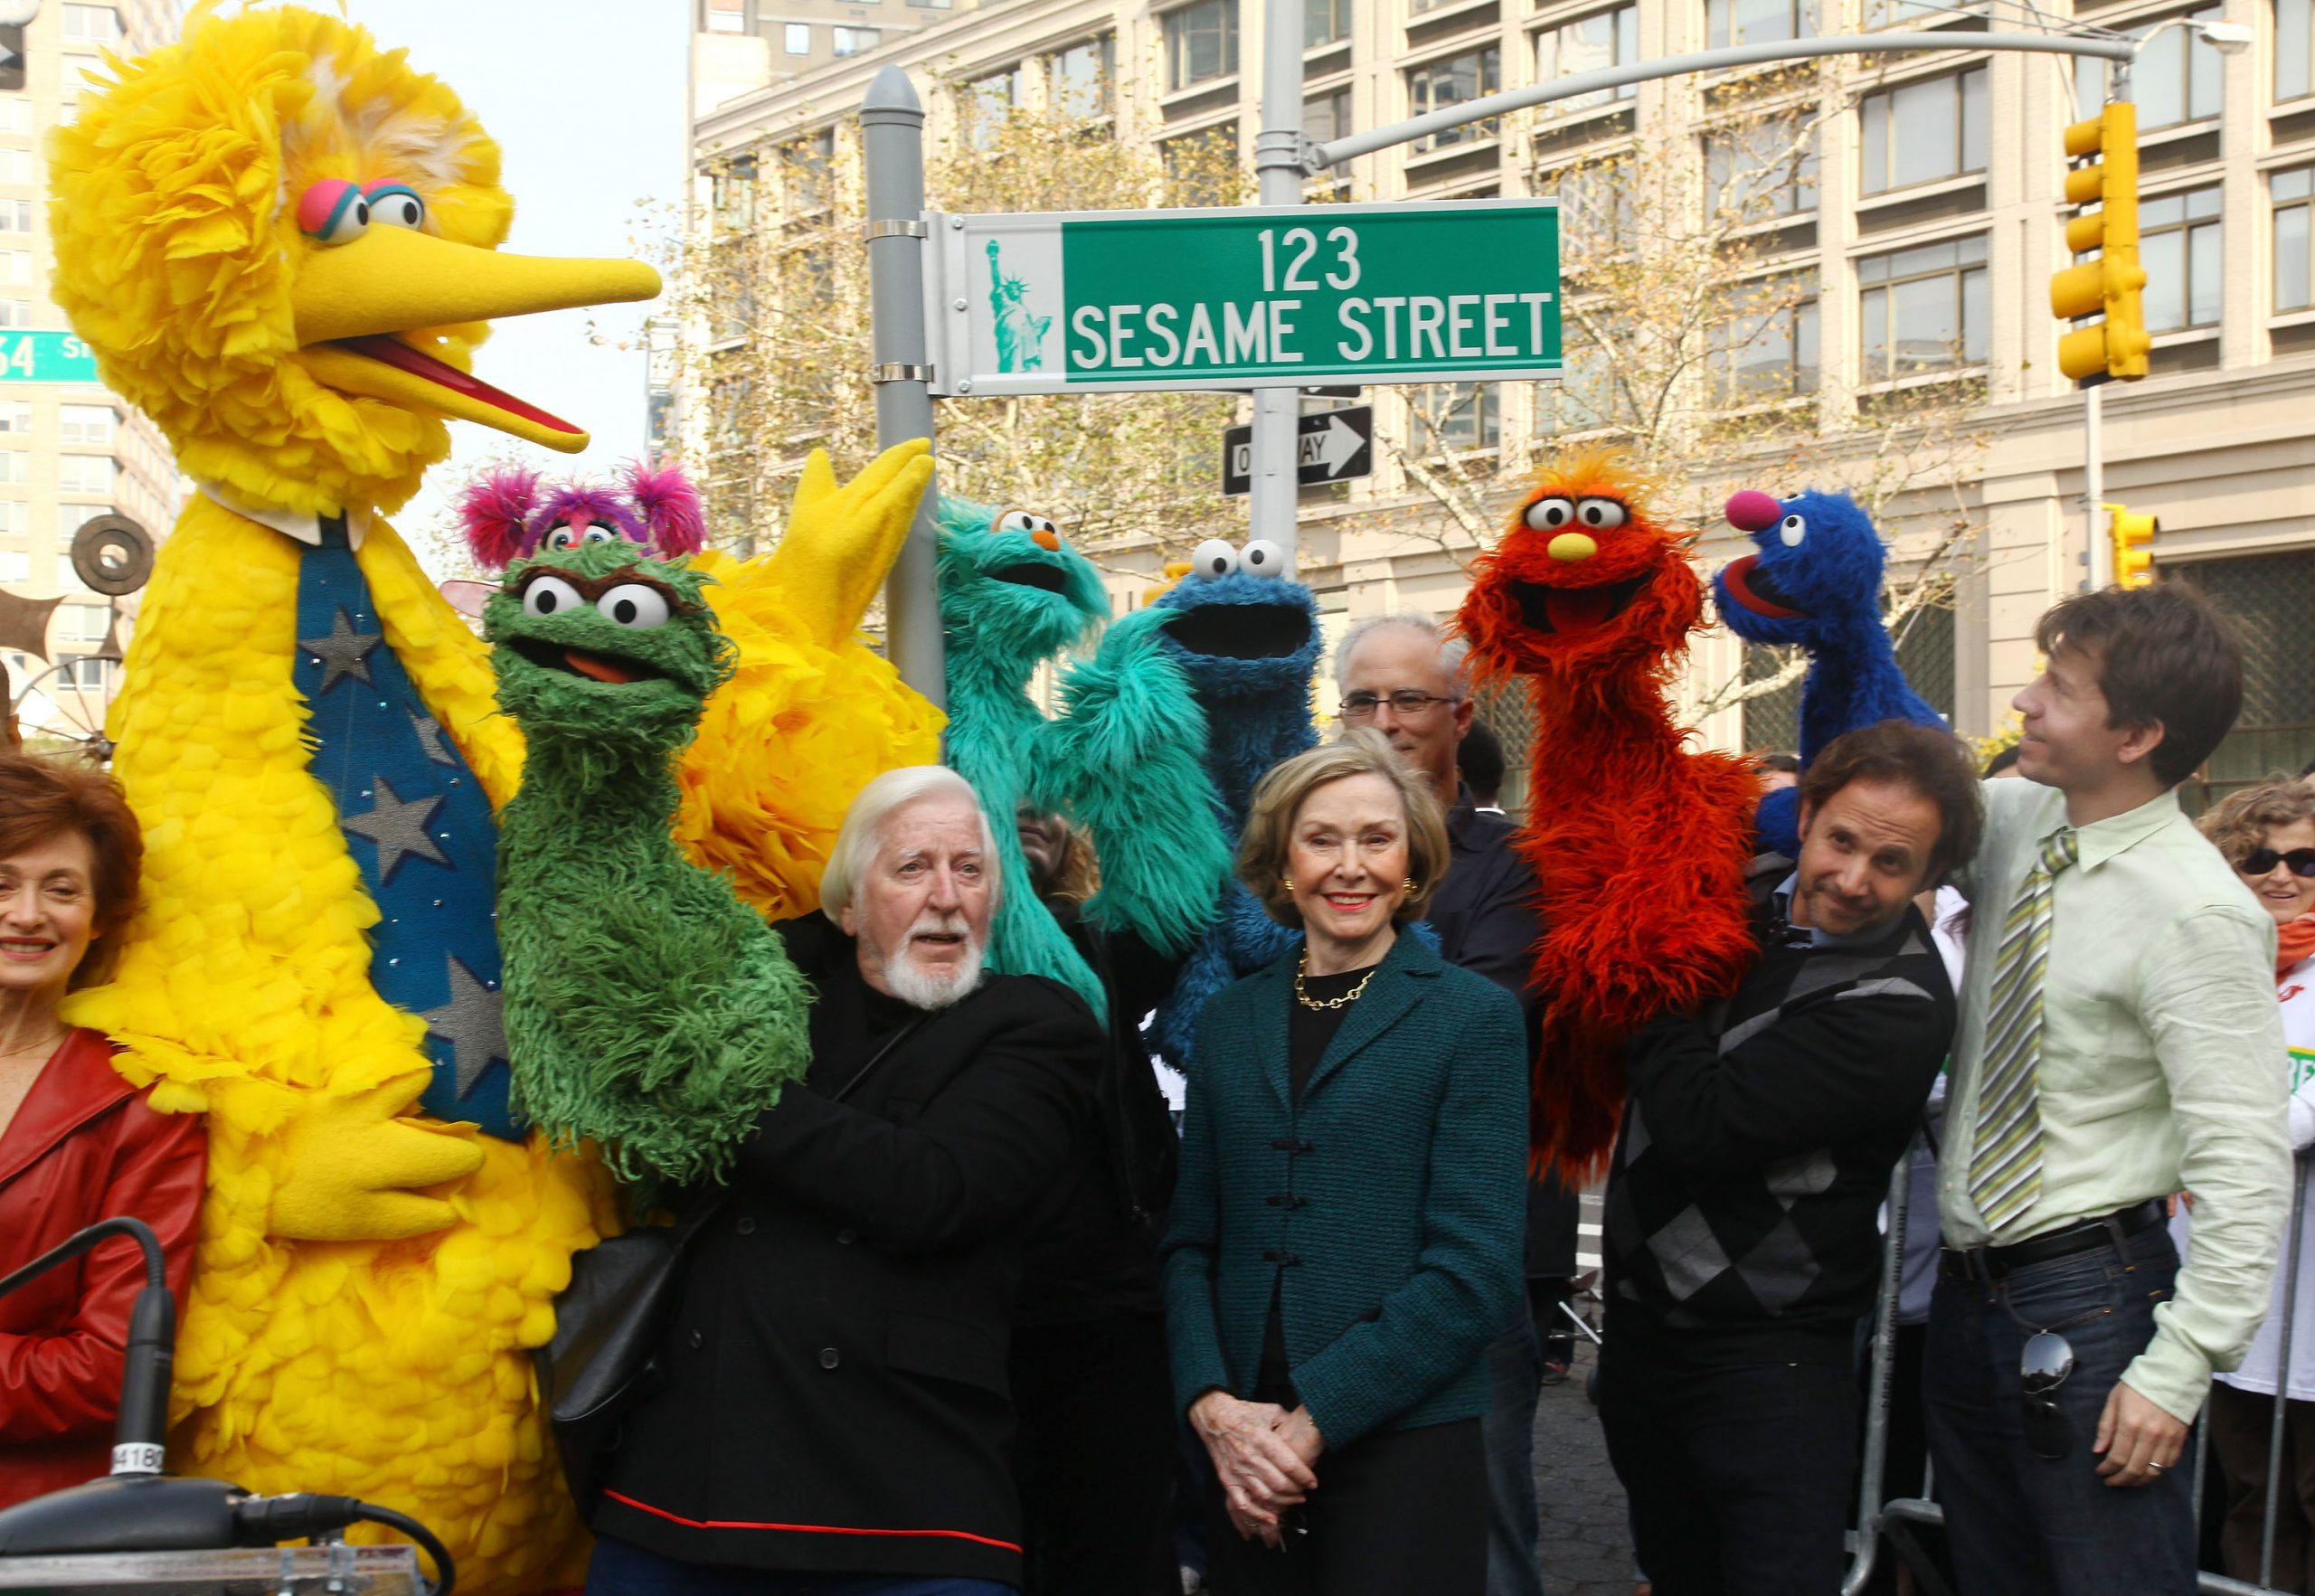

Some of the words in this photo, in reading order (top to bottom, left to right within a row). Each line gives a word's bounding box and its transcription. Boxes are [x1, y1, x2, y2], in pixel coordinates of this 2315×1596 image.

[1258, 227, 1361, 292] 123
[1072, 299, 1305, 369] SESAME
[1337, 292, 1554, 361] STREET
